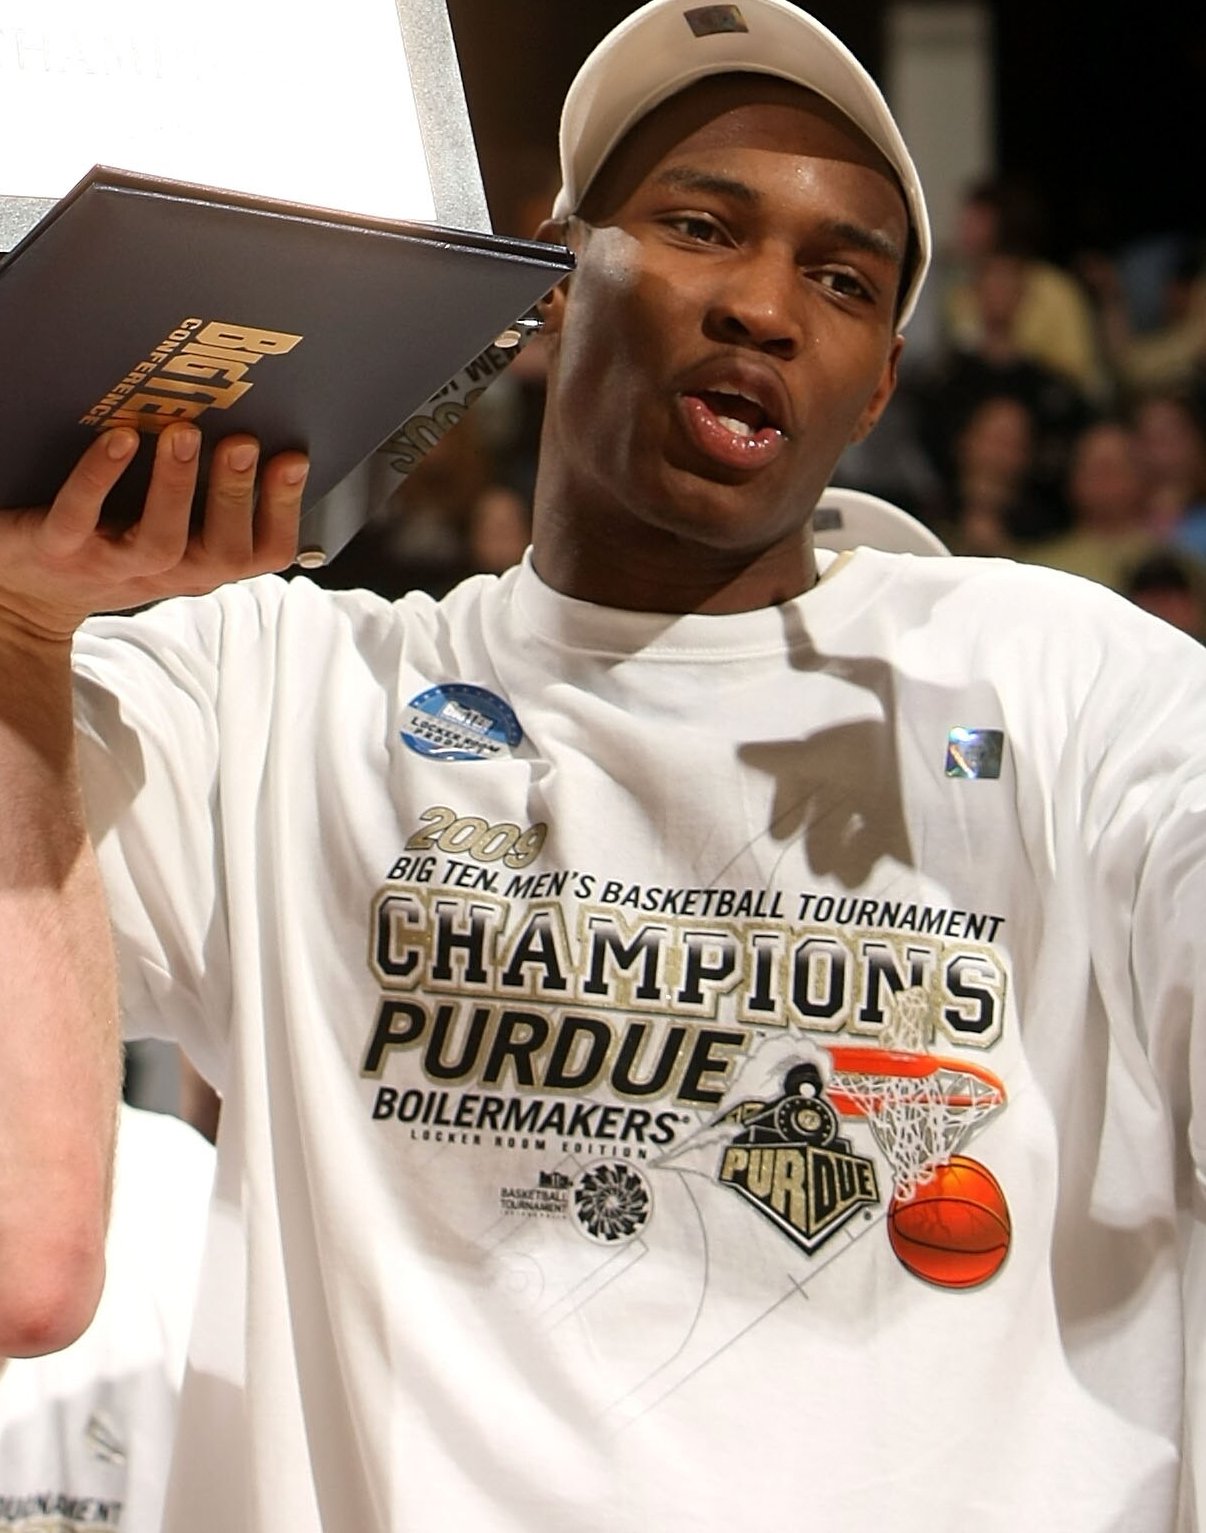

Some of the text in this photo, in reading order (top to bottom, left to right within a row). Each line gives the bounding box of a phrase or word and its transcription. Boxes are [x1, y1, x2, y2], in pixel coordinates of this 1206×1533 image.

[79, 318, 203, 426] CONFERENCE
[405, 806, 548, 869] 2009
[387, 856, 1005, 943] BIG TEN MEN'S BASKETBALL TOURNAMENT
[370, 887, 1006, 1045] CHAMPIONS
[361, 995, 748, 1108] PURDUE
[371, 1087, 680, 1145] BOILERMAKERS
[410, 1129, 648, 1160] LOCKER ROOM EDITION
[500, 1187, 568, 1202] BASKETBALL
[500, 1198, 568, 1213] TOURNAMENT
[722, 1146, 876, 1235] PURDUE
